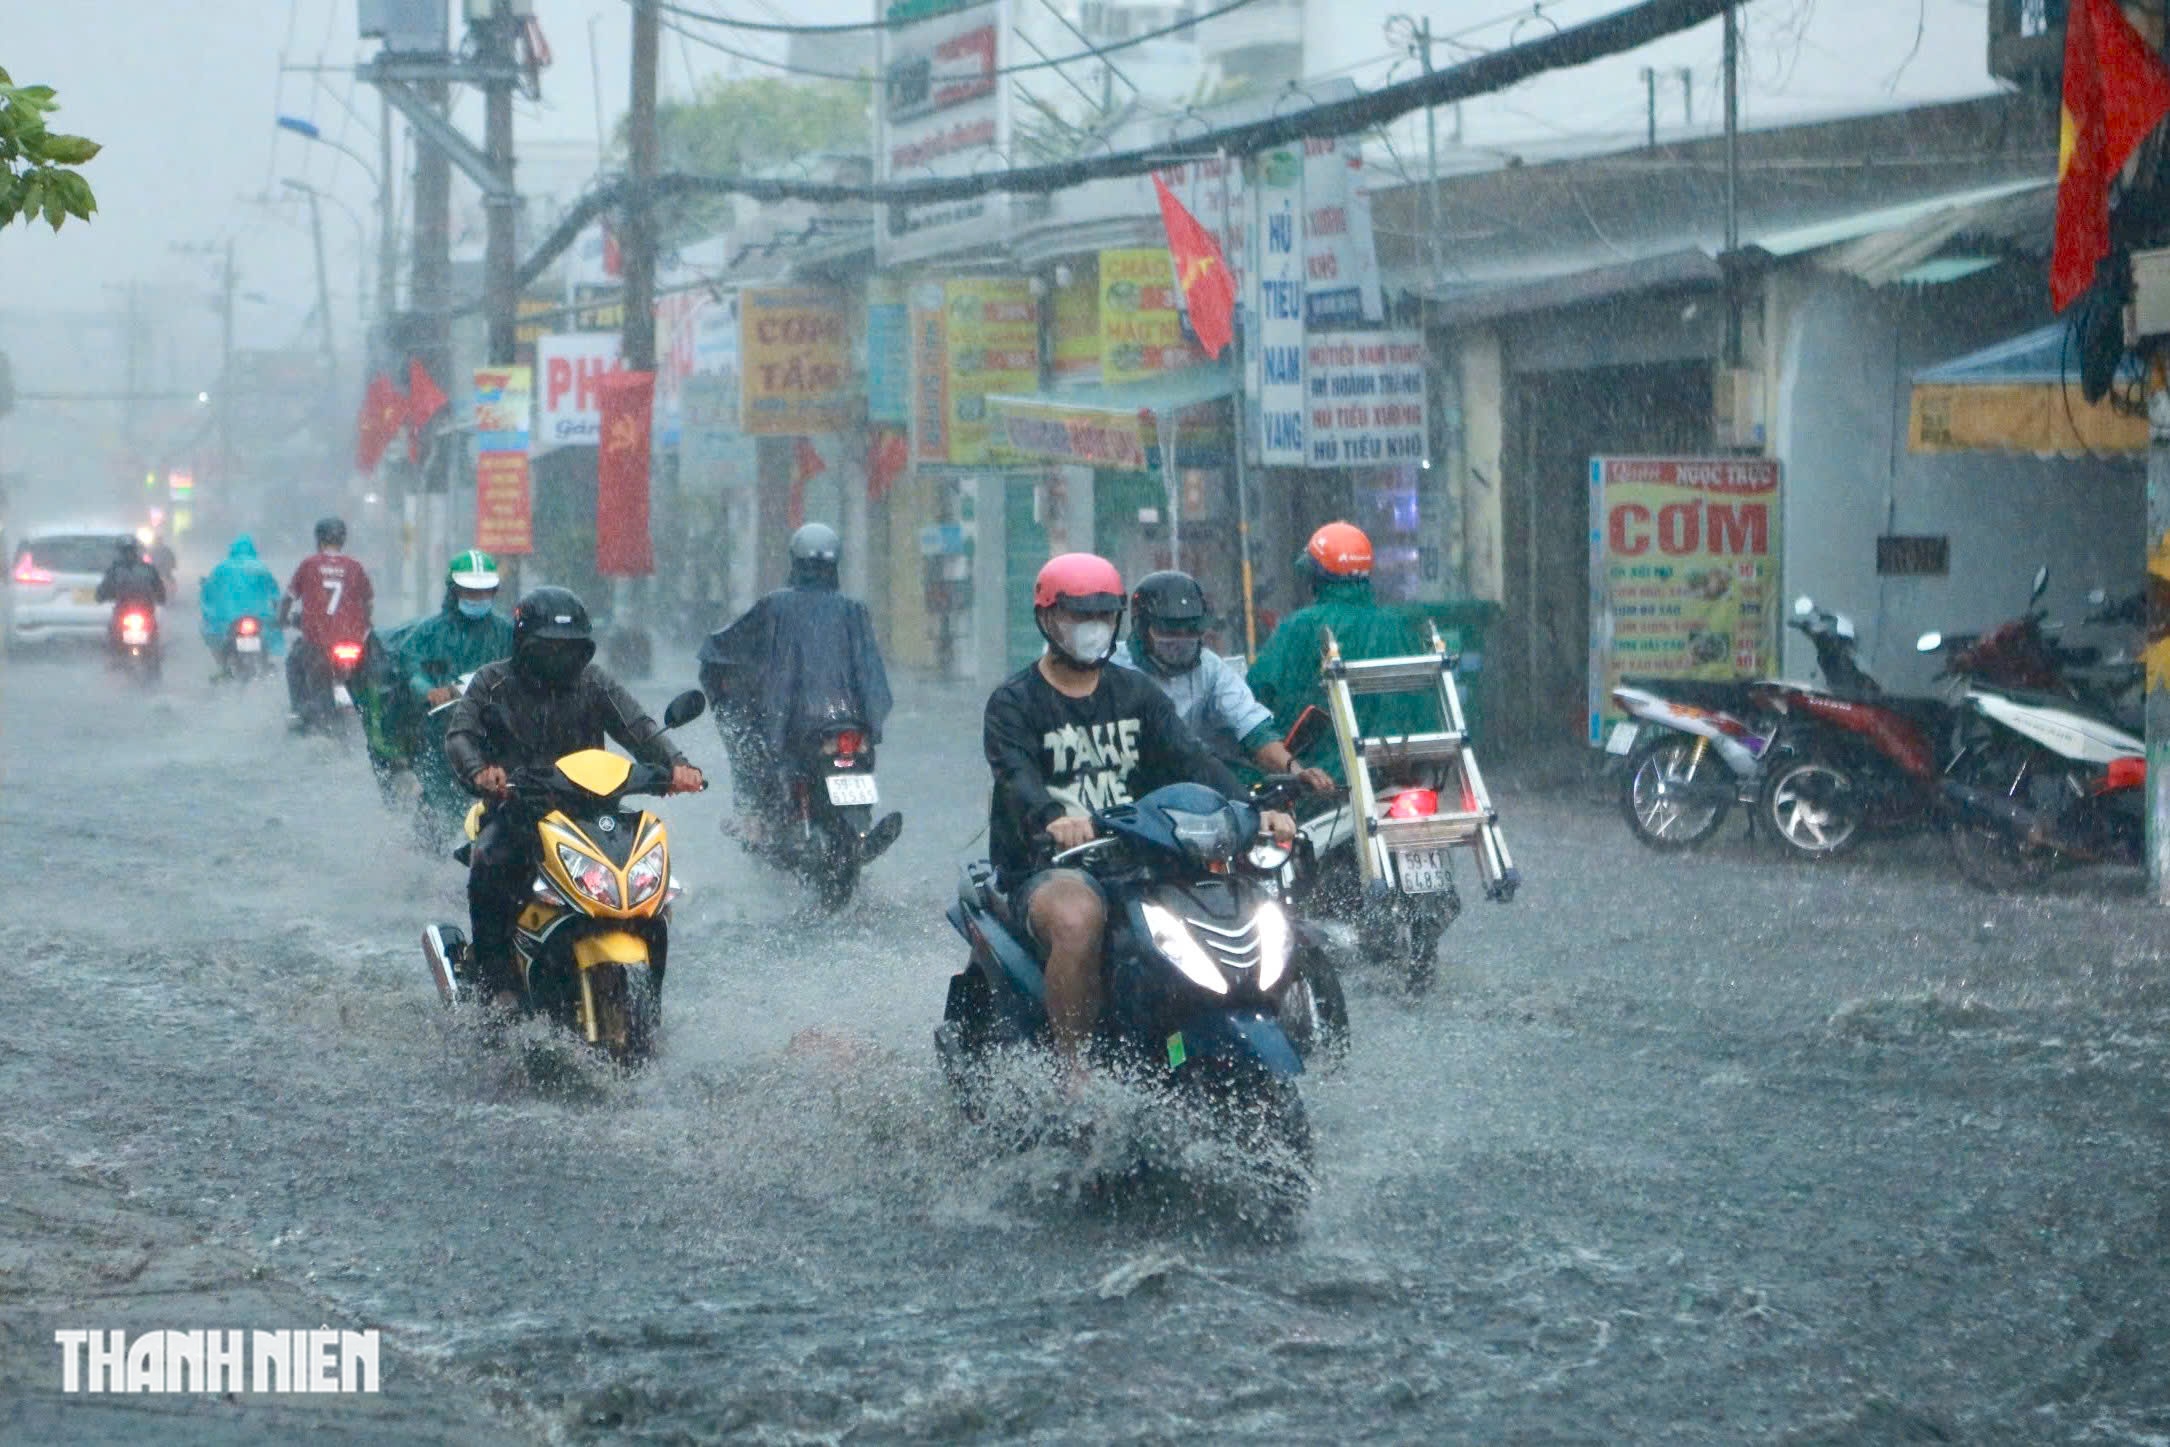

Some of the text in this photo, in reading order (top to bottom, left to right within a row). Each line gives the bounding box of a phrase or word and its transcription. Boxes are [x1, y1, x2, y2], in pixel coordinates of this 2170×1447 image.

[1264, 346, 1299, 385] NAM
[1608, 498, 1768, 557] CƠM
[322, 580, 342, 615] 7
